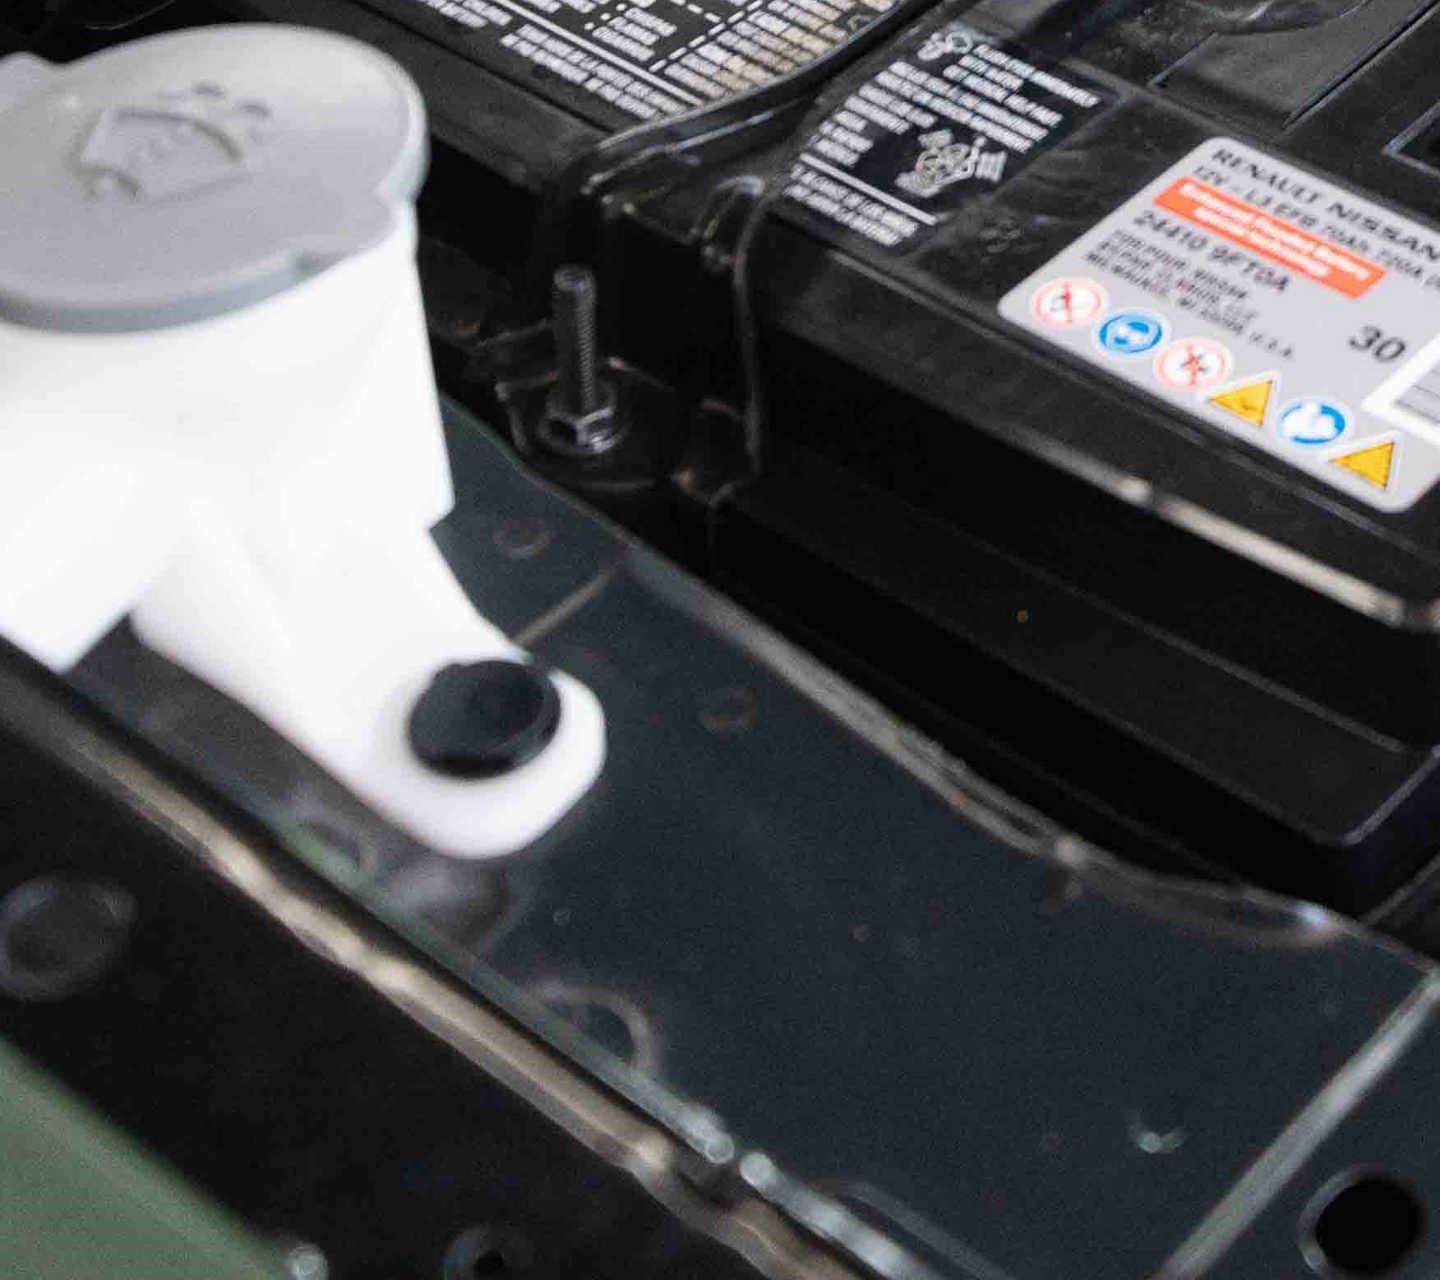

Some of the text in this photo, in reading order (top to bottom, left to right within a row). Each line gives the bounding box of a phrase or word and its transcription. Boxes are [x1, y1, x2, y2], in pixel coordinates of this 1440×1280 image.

[1212, 148, 1322, 203] RENAULT
[1133, 209, 1208, 251] 24410
[1348, 324, 1407, 363] 30
